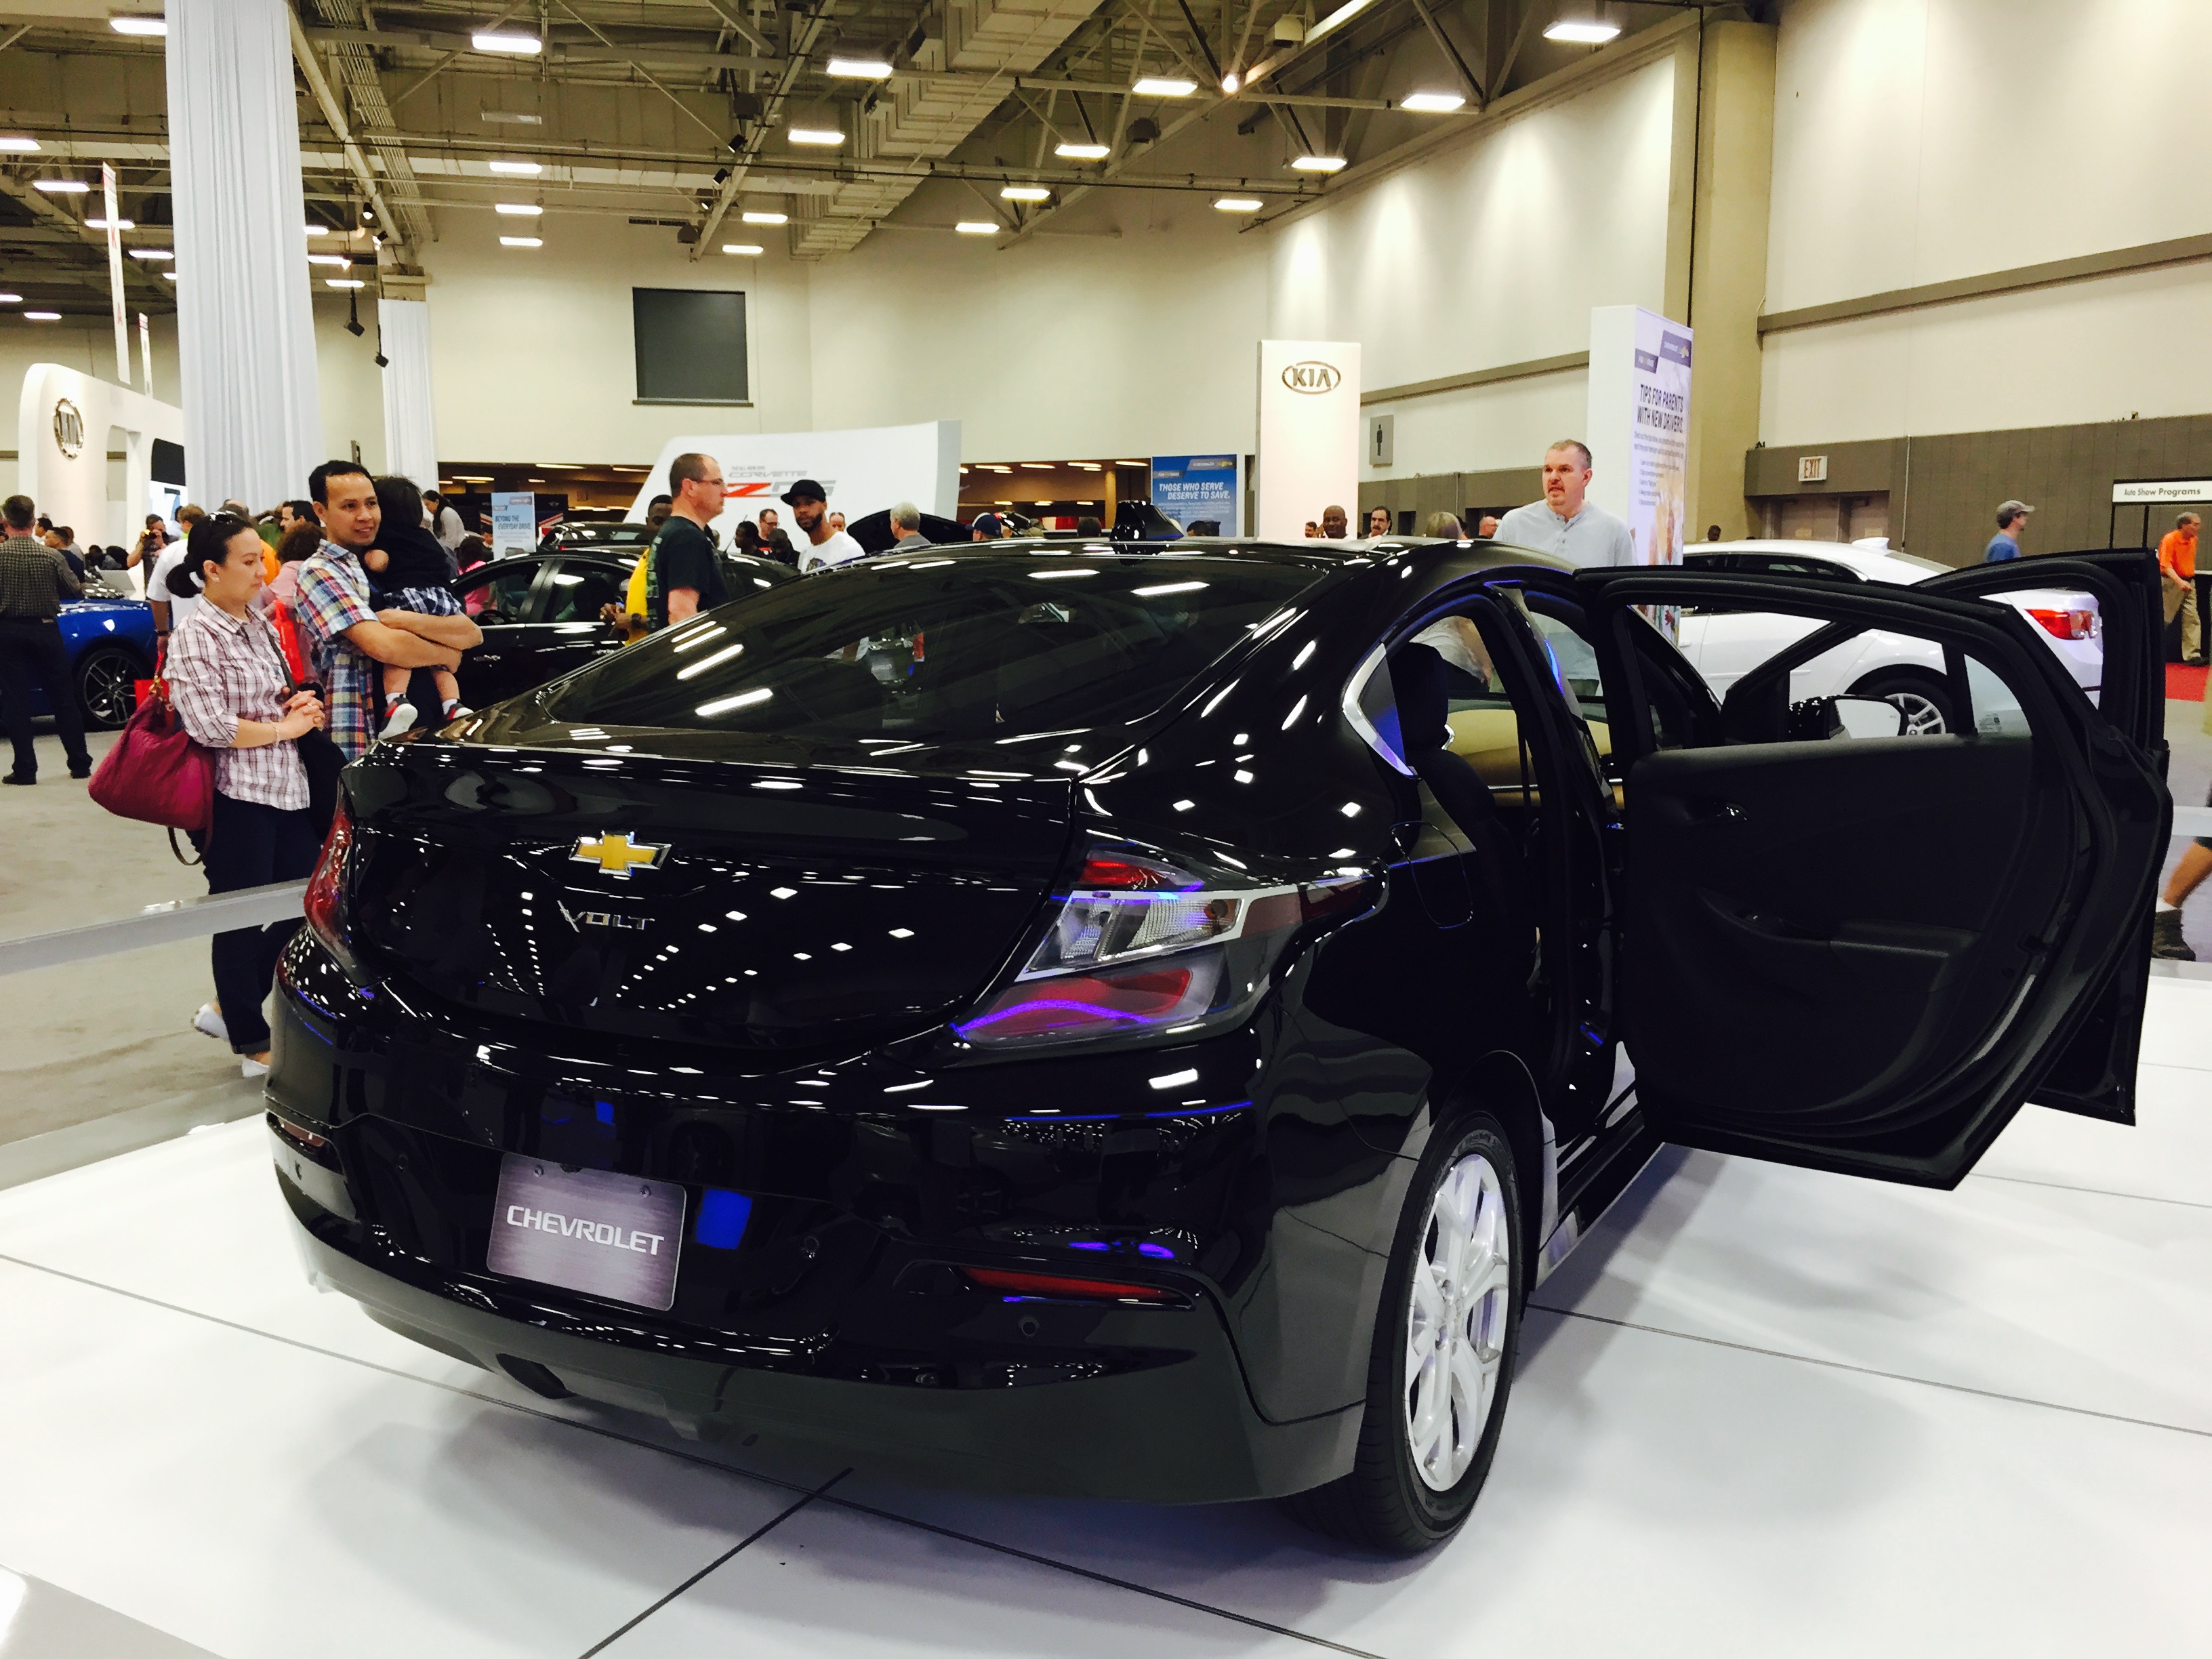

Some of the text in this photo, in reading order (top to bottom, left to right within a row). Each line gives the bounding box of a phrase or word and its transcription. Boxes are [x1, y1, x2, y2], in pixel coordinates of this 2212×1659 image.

[1292, 368, 1332, 387] KIA
[1640, 384, 1684, 413] TIPS FOR PARENTS
[1637, 405, 1652, 426] WITH
[1652, 409, 1664, 428] NEW
[1804, 458, 1822, 478] EXIT
[1159, 482, 1225, 491] THOSE WHO SERVE
[1168, 491, 1231, 499] DESERVE TO SAVE.
[2158, 487, 2201, 497] Programs
[557, 900, 655, 933] VOLT
[506, 1205, 665, 1256] CHEVROLET
